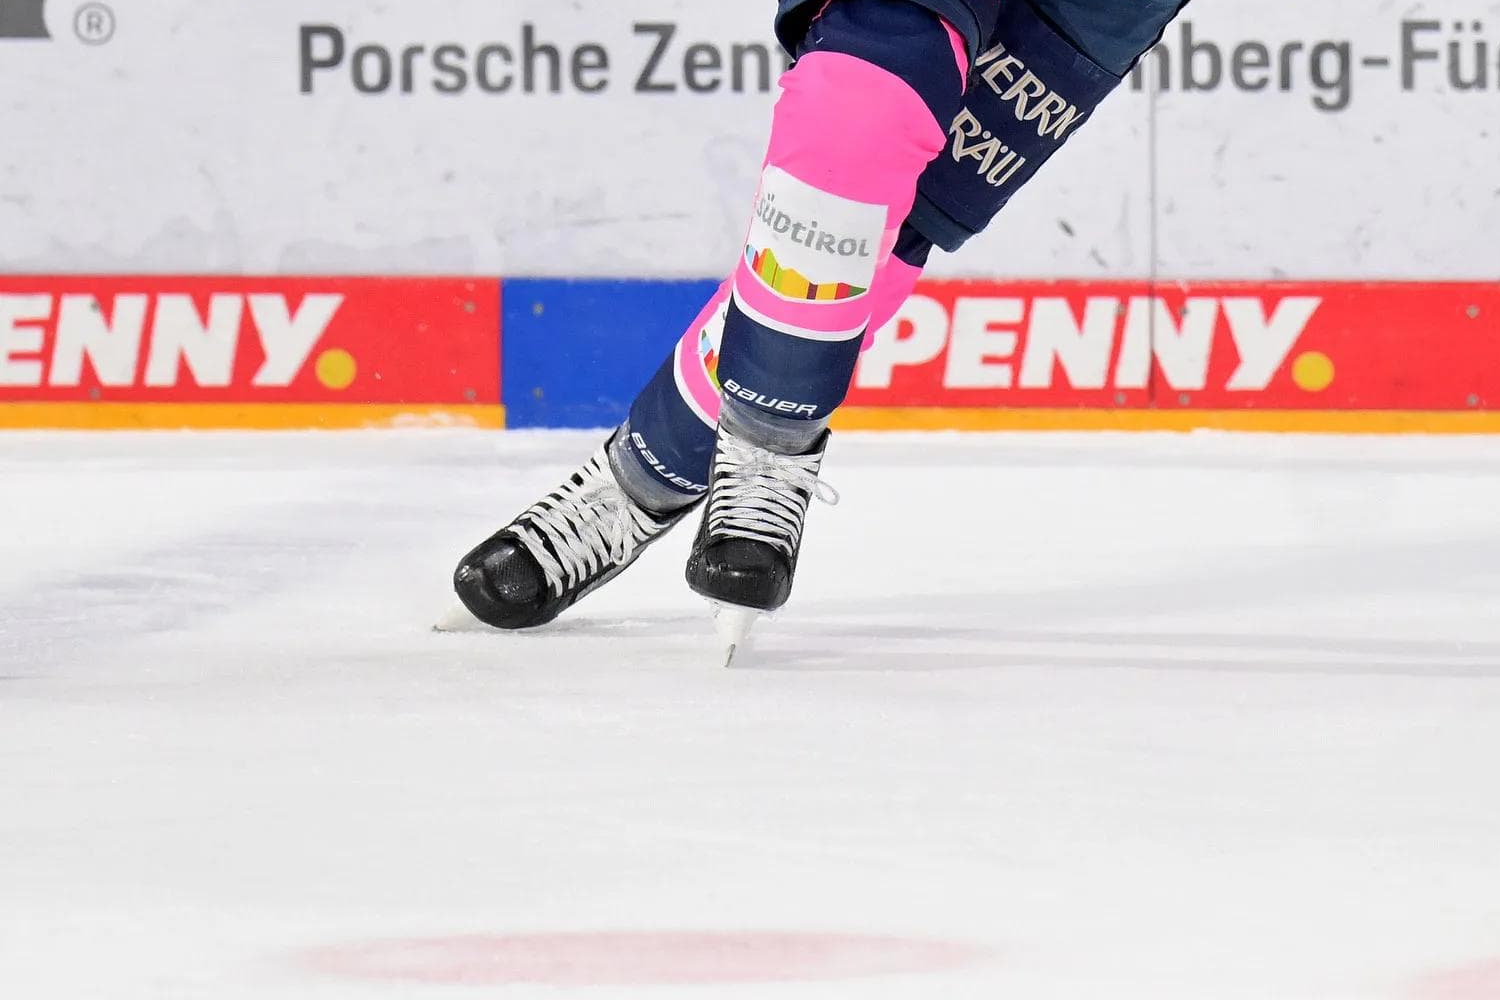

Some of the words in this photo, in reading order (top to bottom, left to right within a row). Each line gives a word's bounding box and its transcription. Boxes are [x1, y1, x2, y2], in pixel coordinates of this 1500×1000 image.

[299, 24, 610, 96] Porsche
[949, 106, 1026, 187] RÄU
[0, 294, 356, 390] ENNY.
